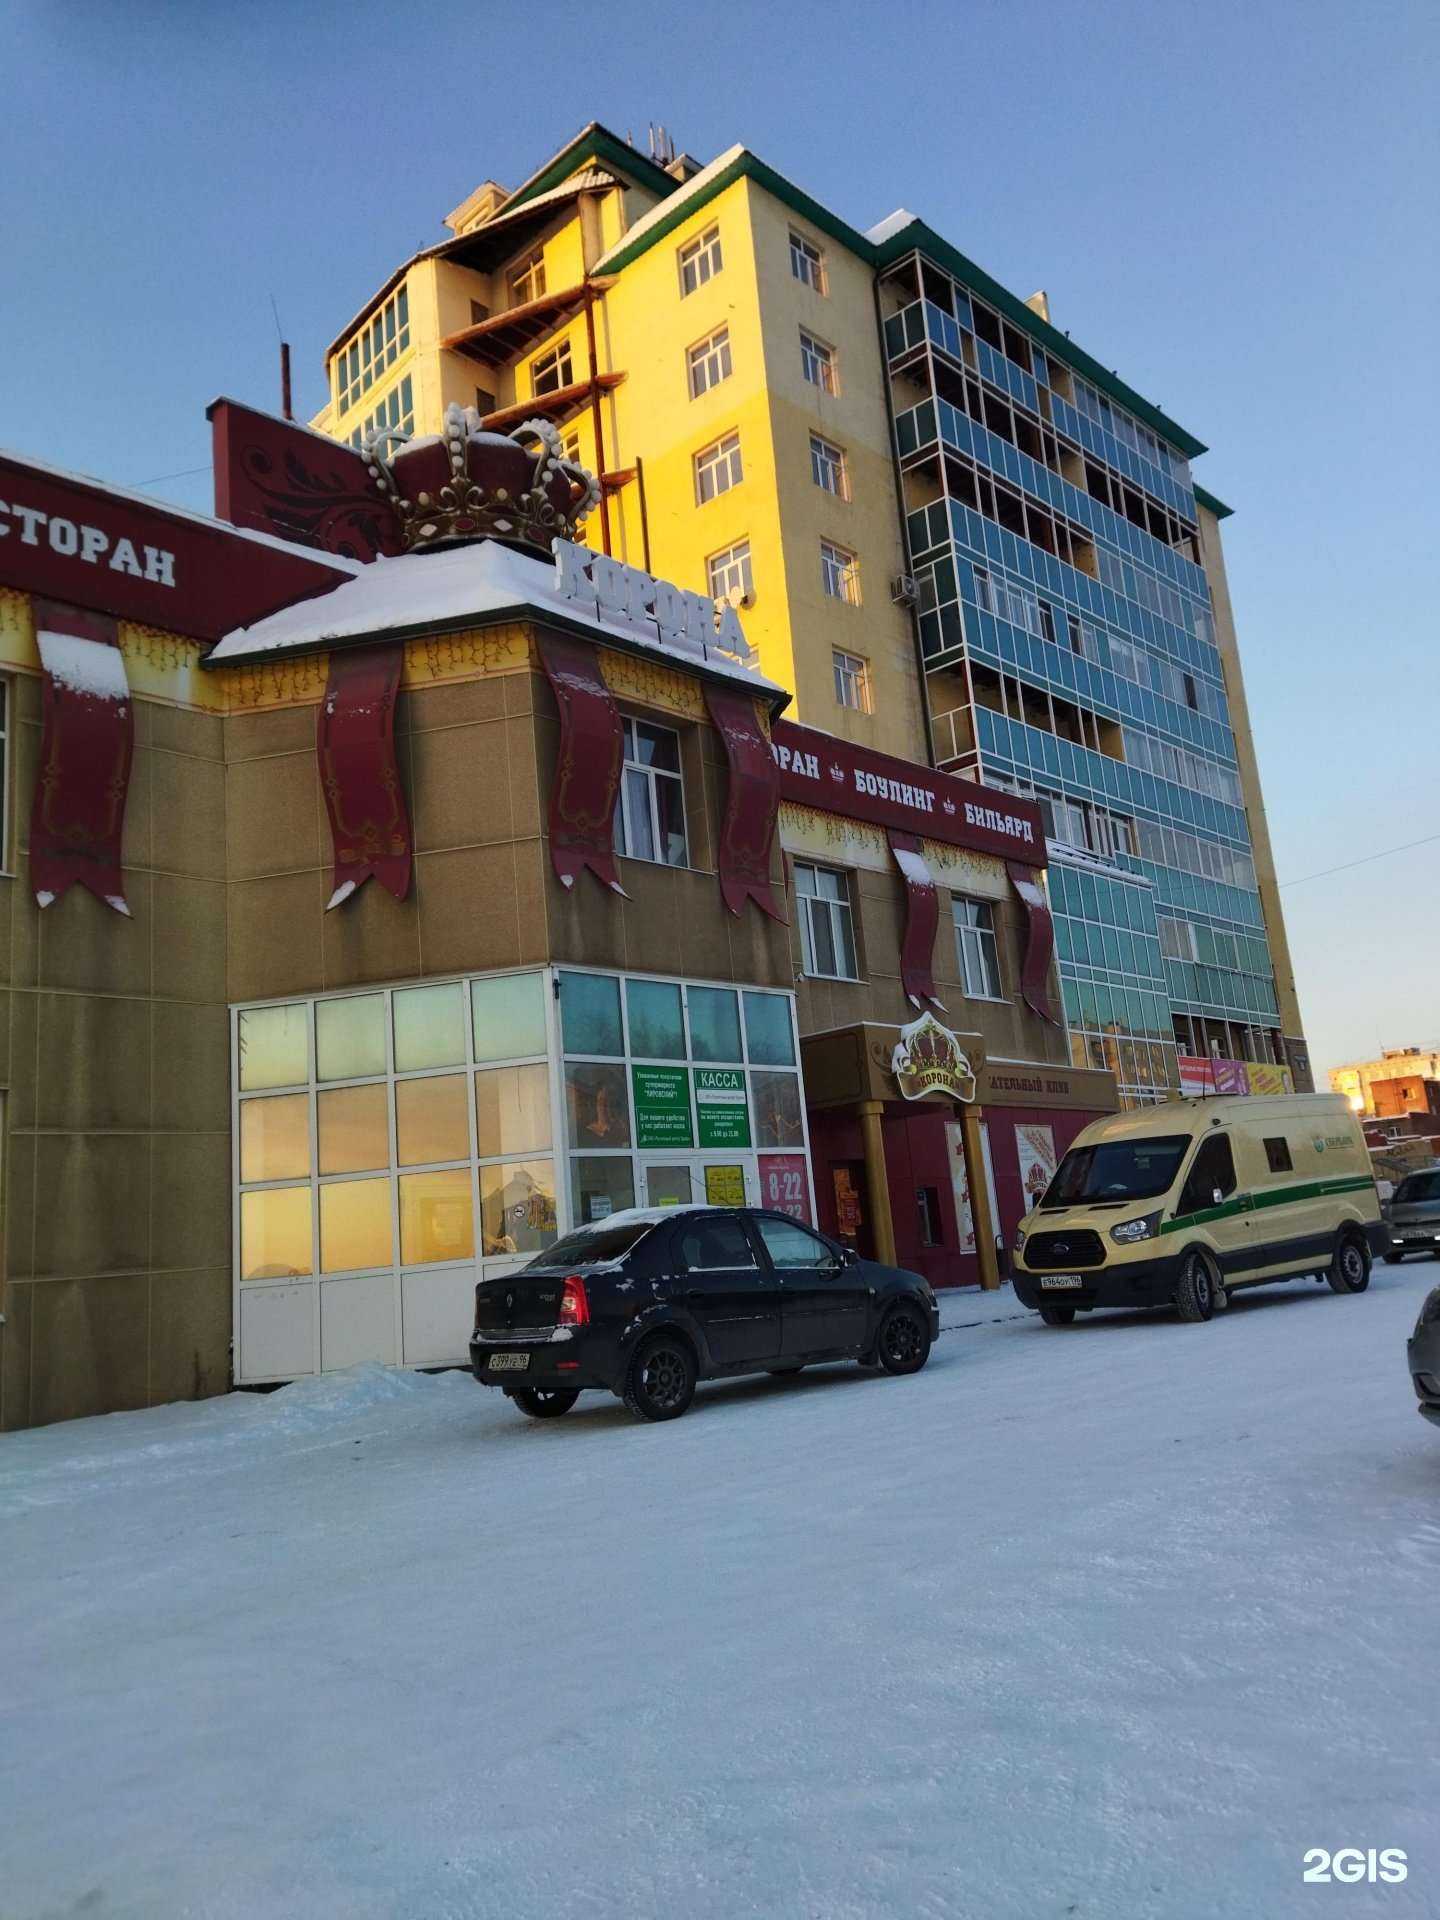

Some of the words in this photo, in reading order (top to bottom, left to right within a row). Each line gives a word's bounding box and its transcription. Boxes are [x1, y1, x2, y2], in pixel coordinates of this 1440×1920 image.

[551, 536, 751, 659] КОРОНА
[853, 768, 935, 813] БОУЛИНГ
[964, 802, 1034, 843] БИЛЬЯРД
[701, 1072, 739, 1088] КАССА
[988, 1075, 1043, 1093] АТЕЛЬНЫЙ
[768, 1171, 803, 1201] 8-22
